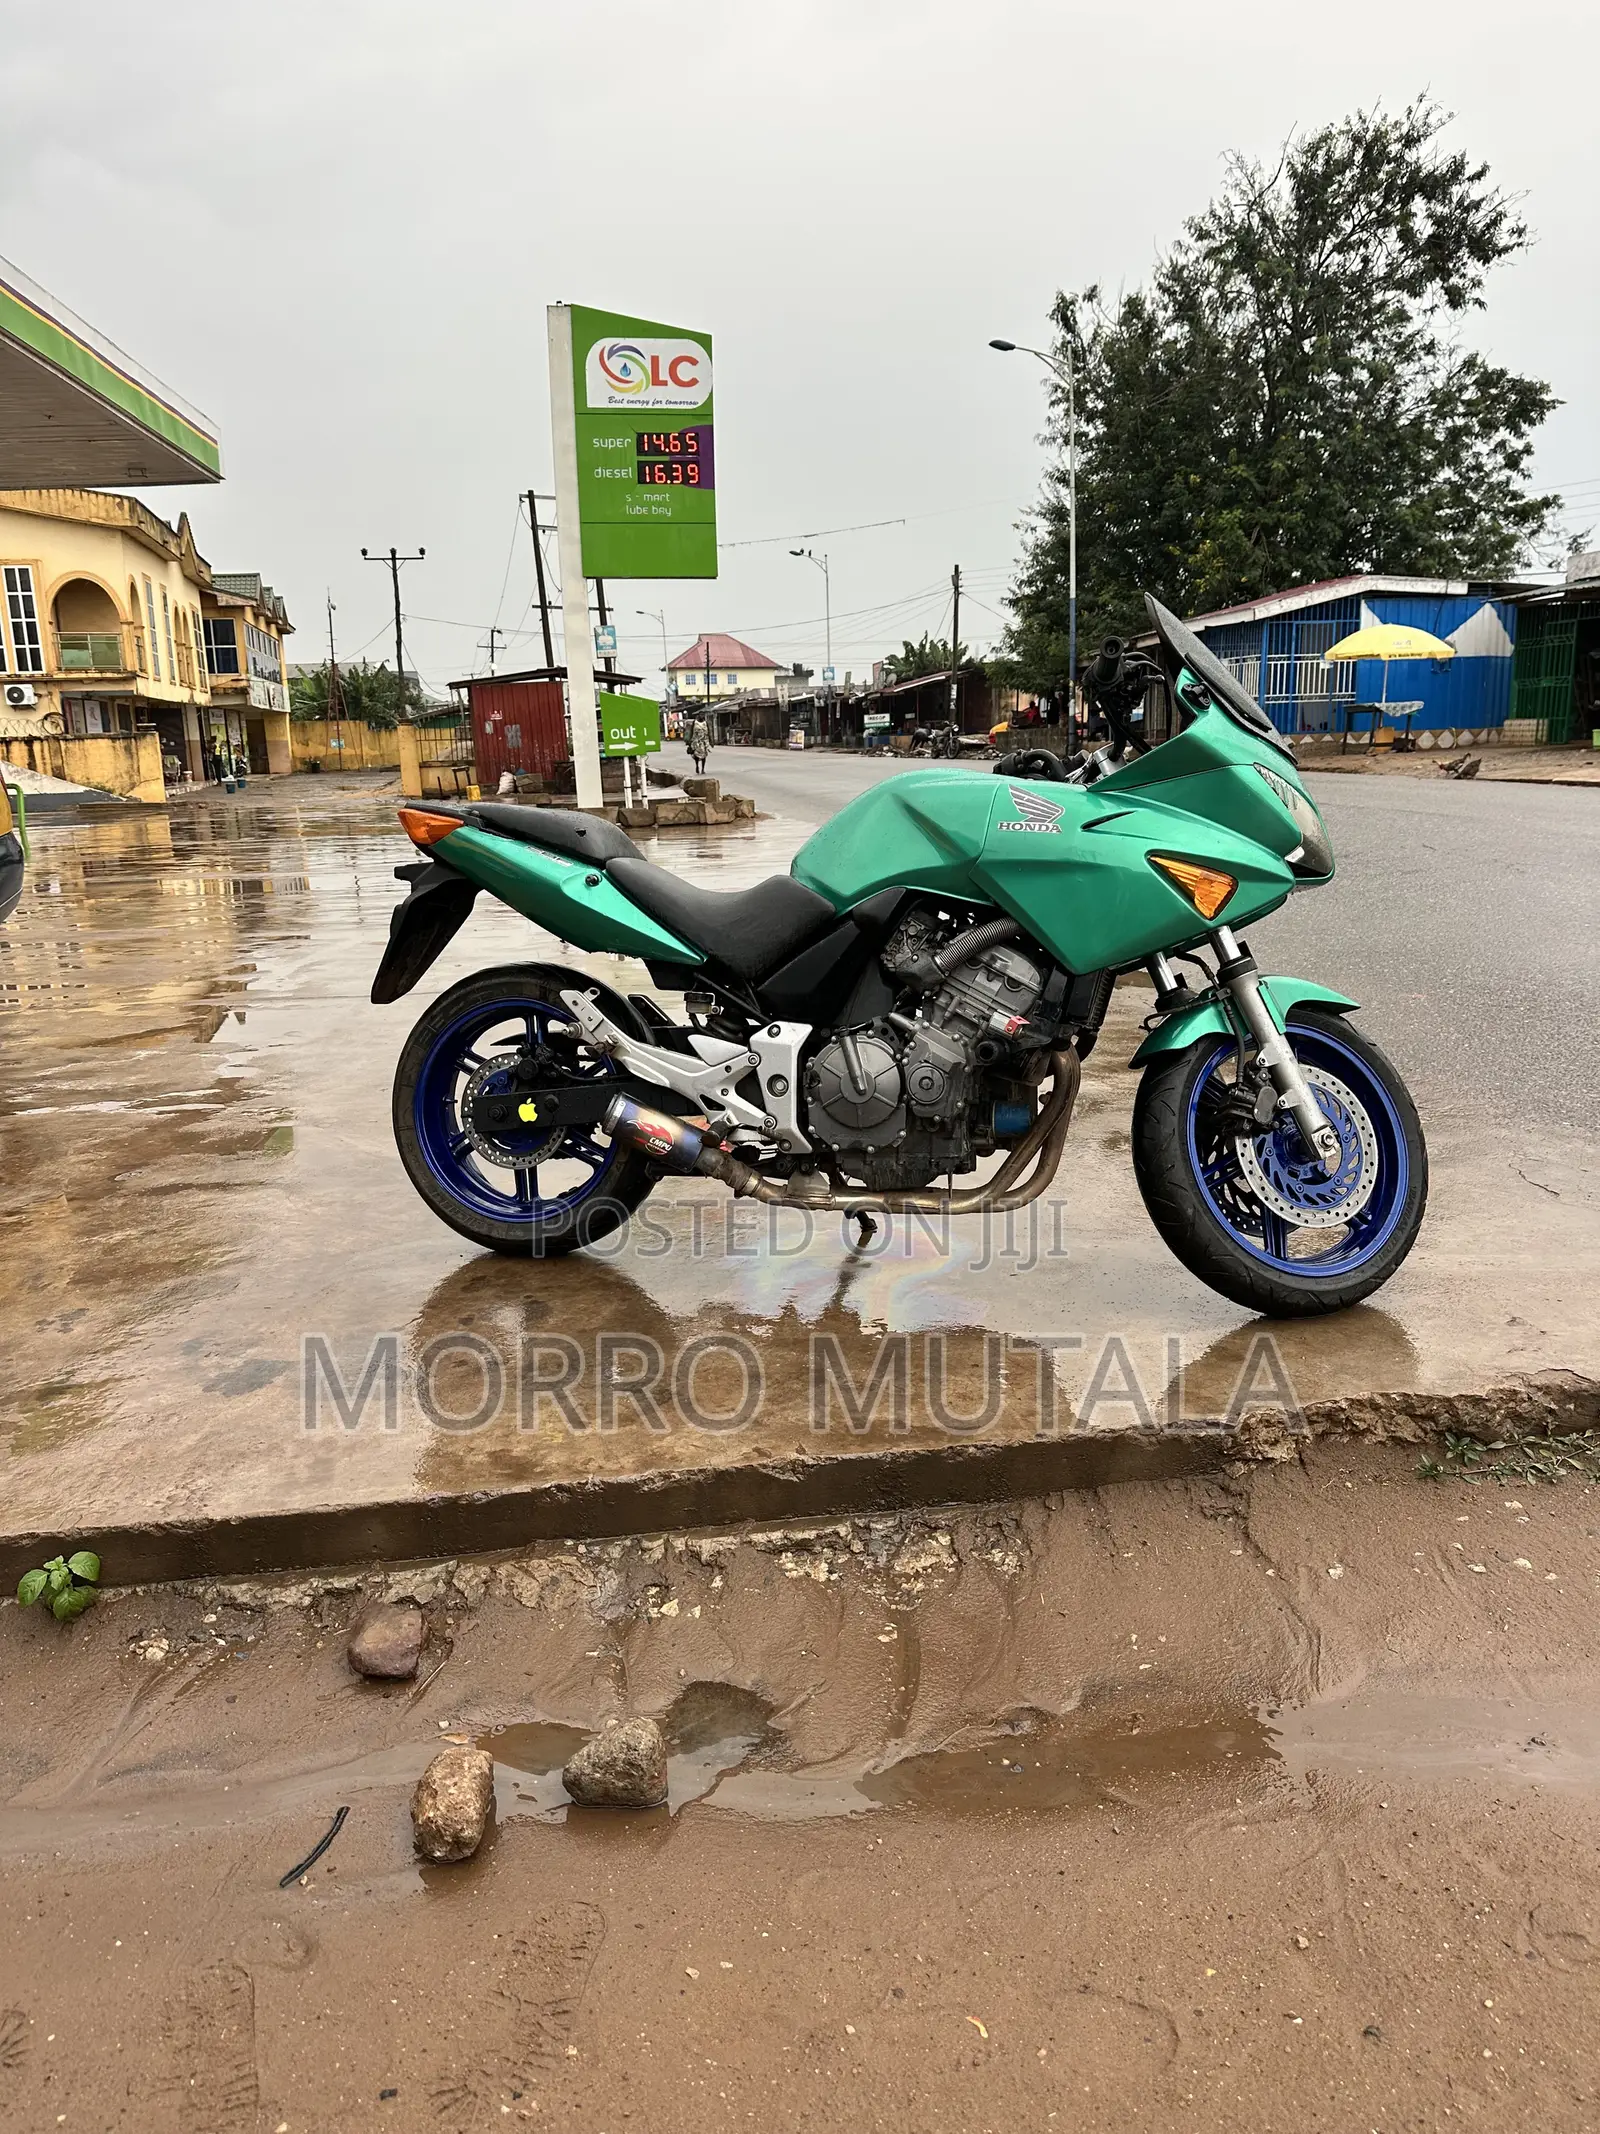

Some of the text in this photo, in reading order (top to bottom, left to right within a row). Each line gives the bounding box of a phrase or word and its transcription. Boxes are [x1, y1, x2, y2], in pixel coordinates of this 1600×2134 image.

[607, 396, 699, 407] Best energy for tomorrow
[592, 438, 632, 450] super
[643, 433, 698, 453] 14.65
[594, 467, 633, 479] diesel
[644, 464, 699, 484] 16.39
[643, 493, 670, 501] mart
[626, 505, 672, 517] lube bay
[610, 725, 637, 739] out
[998, 821, 1062, 833] HONDA
